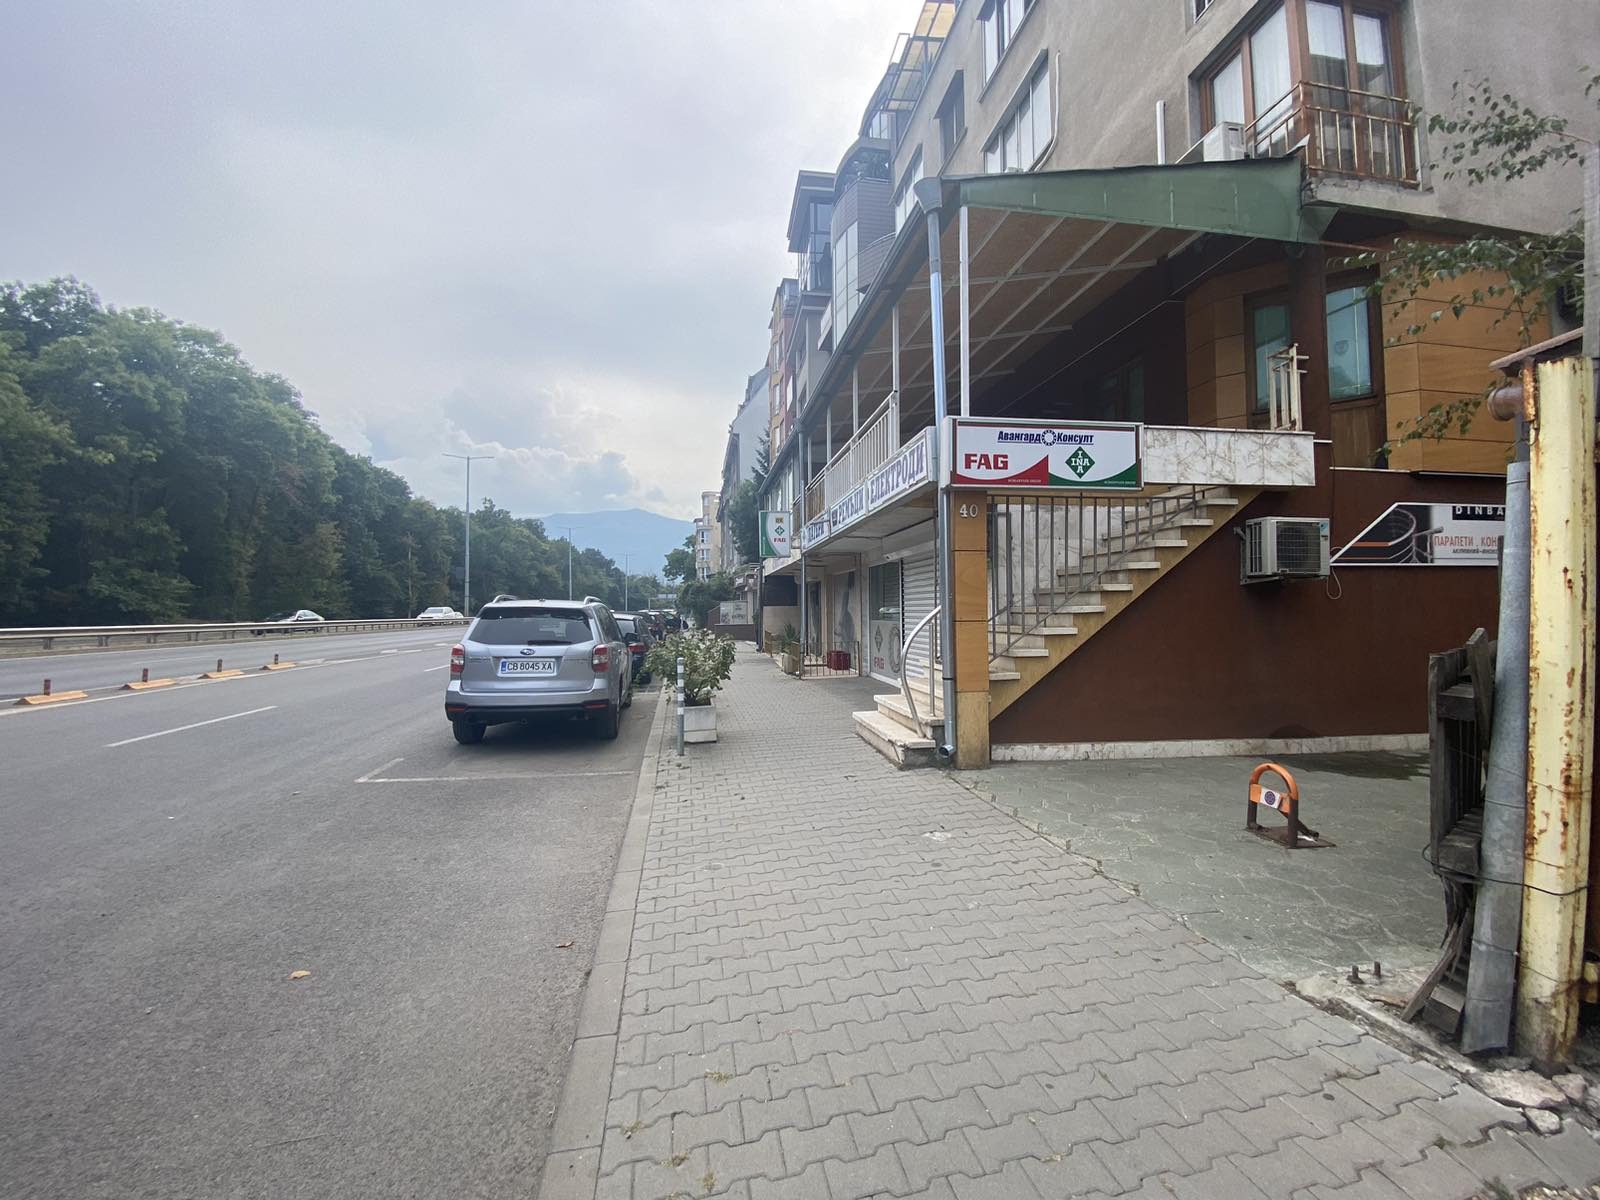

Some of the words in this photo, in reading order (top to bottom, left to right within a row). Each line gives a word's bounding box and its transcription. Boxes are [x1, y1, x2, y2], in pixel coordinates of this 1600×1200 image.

[998, 430, 1042, 444] Авангард
[1056, 432, 1094, 445] Консулт
[964, 453, 1009, 470] FAG
[870, 440, 925, 505] ЕЛЕКТРОДИ
[960, 503, 978, 518] 40
[1455, 506, 1504, 516] DINBA
[1432, 536, 1473, 547] ПАРАПЕТИ
[1481, 536, 1498, 548] КОН
[507, 662, 518, 671] CB
[520, 662, 540, 671] 8045
[541, 662, 553, 671] XA
[874, 656, 885, 670] FAG
